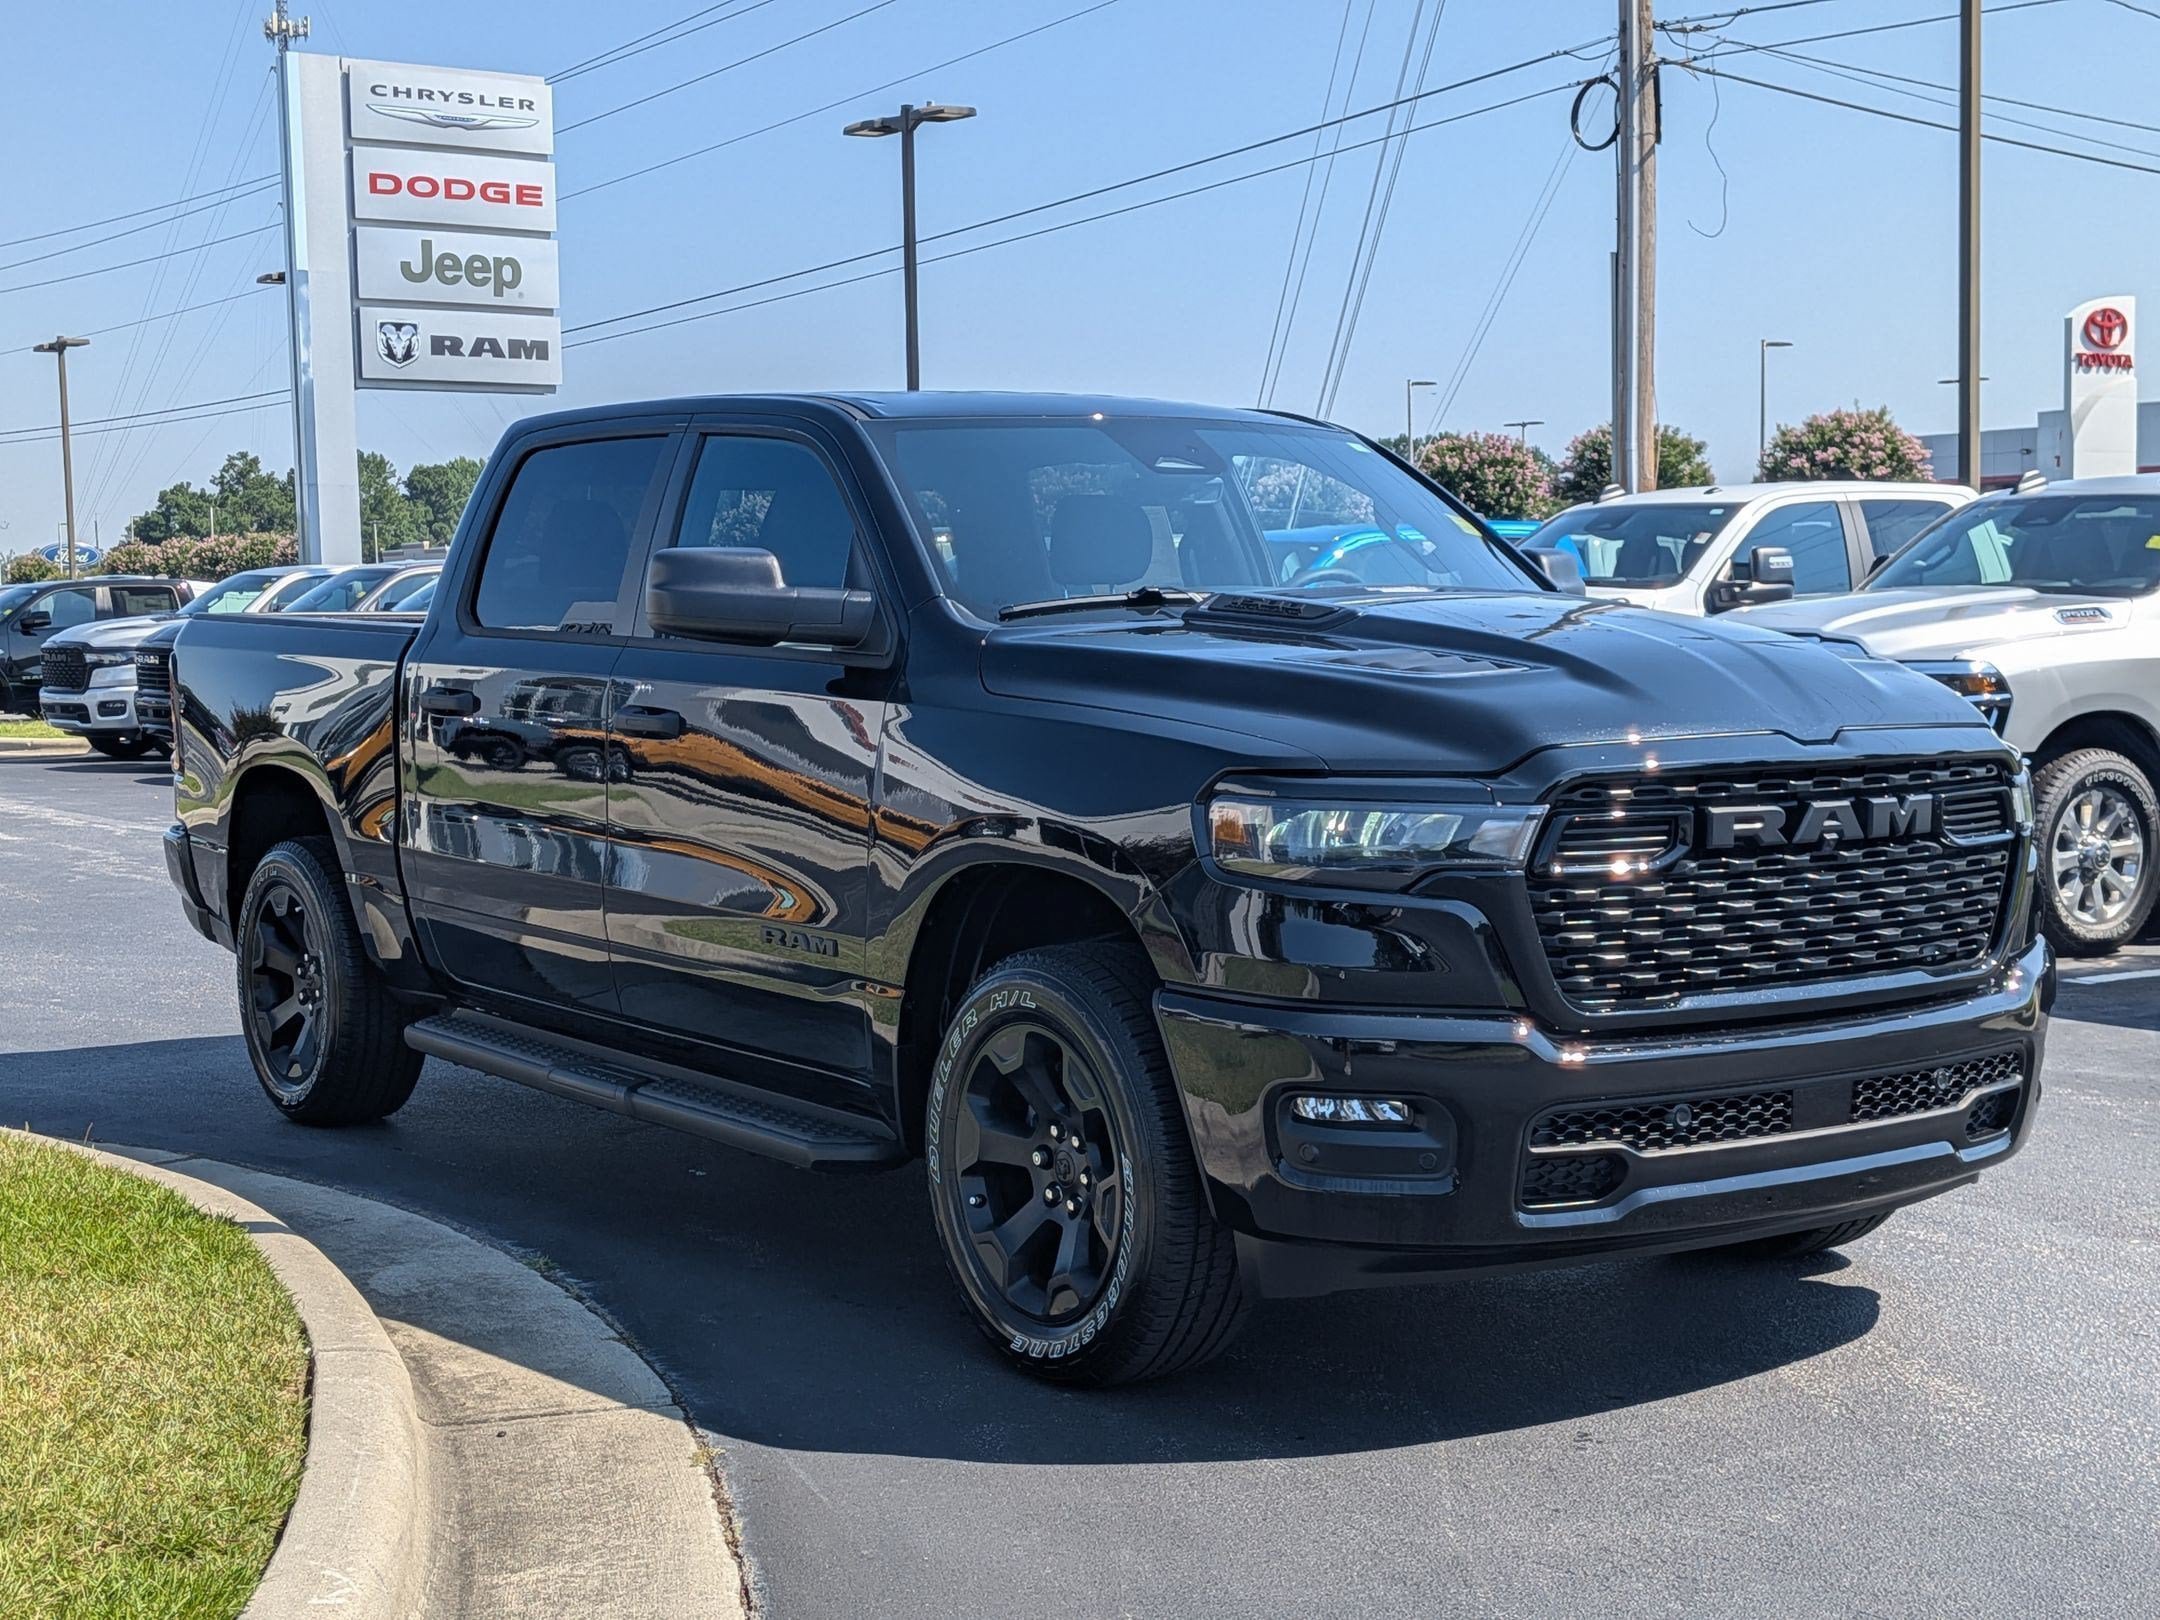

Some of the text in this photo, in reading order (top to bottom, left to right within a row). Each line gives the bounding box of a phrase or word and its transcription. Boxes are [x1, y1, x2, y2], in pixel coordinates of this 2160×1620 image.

[370, 84, 535, 112] CHRYSLER
[368, 172, 543, 206] DODGE
[400, 239, 522, 297] Jeep
[430, 334, 549, 361] RAM
[2076, 353, 2134, 369] TOYOTA
[43, 652, 67, 662] RAM
[1706, 793, 1935, 849] RAM
[761, 925, 839, 957] RAM
[928, 990, 1037, 1184] DUELER H/L
[1010, 1151, 1135, 1359] BRIDGESTONE
